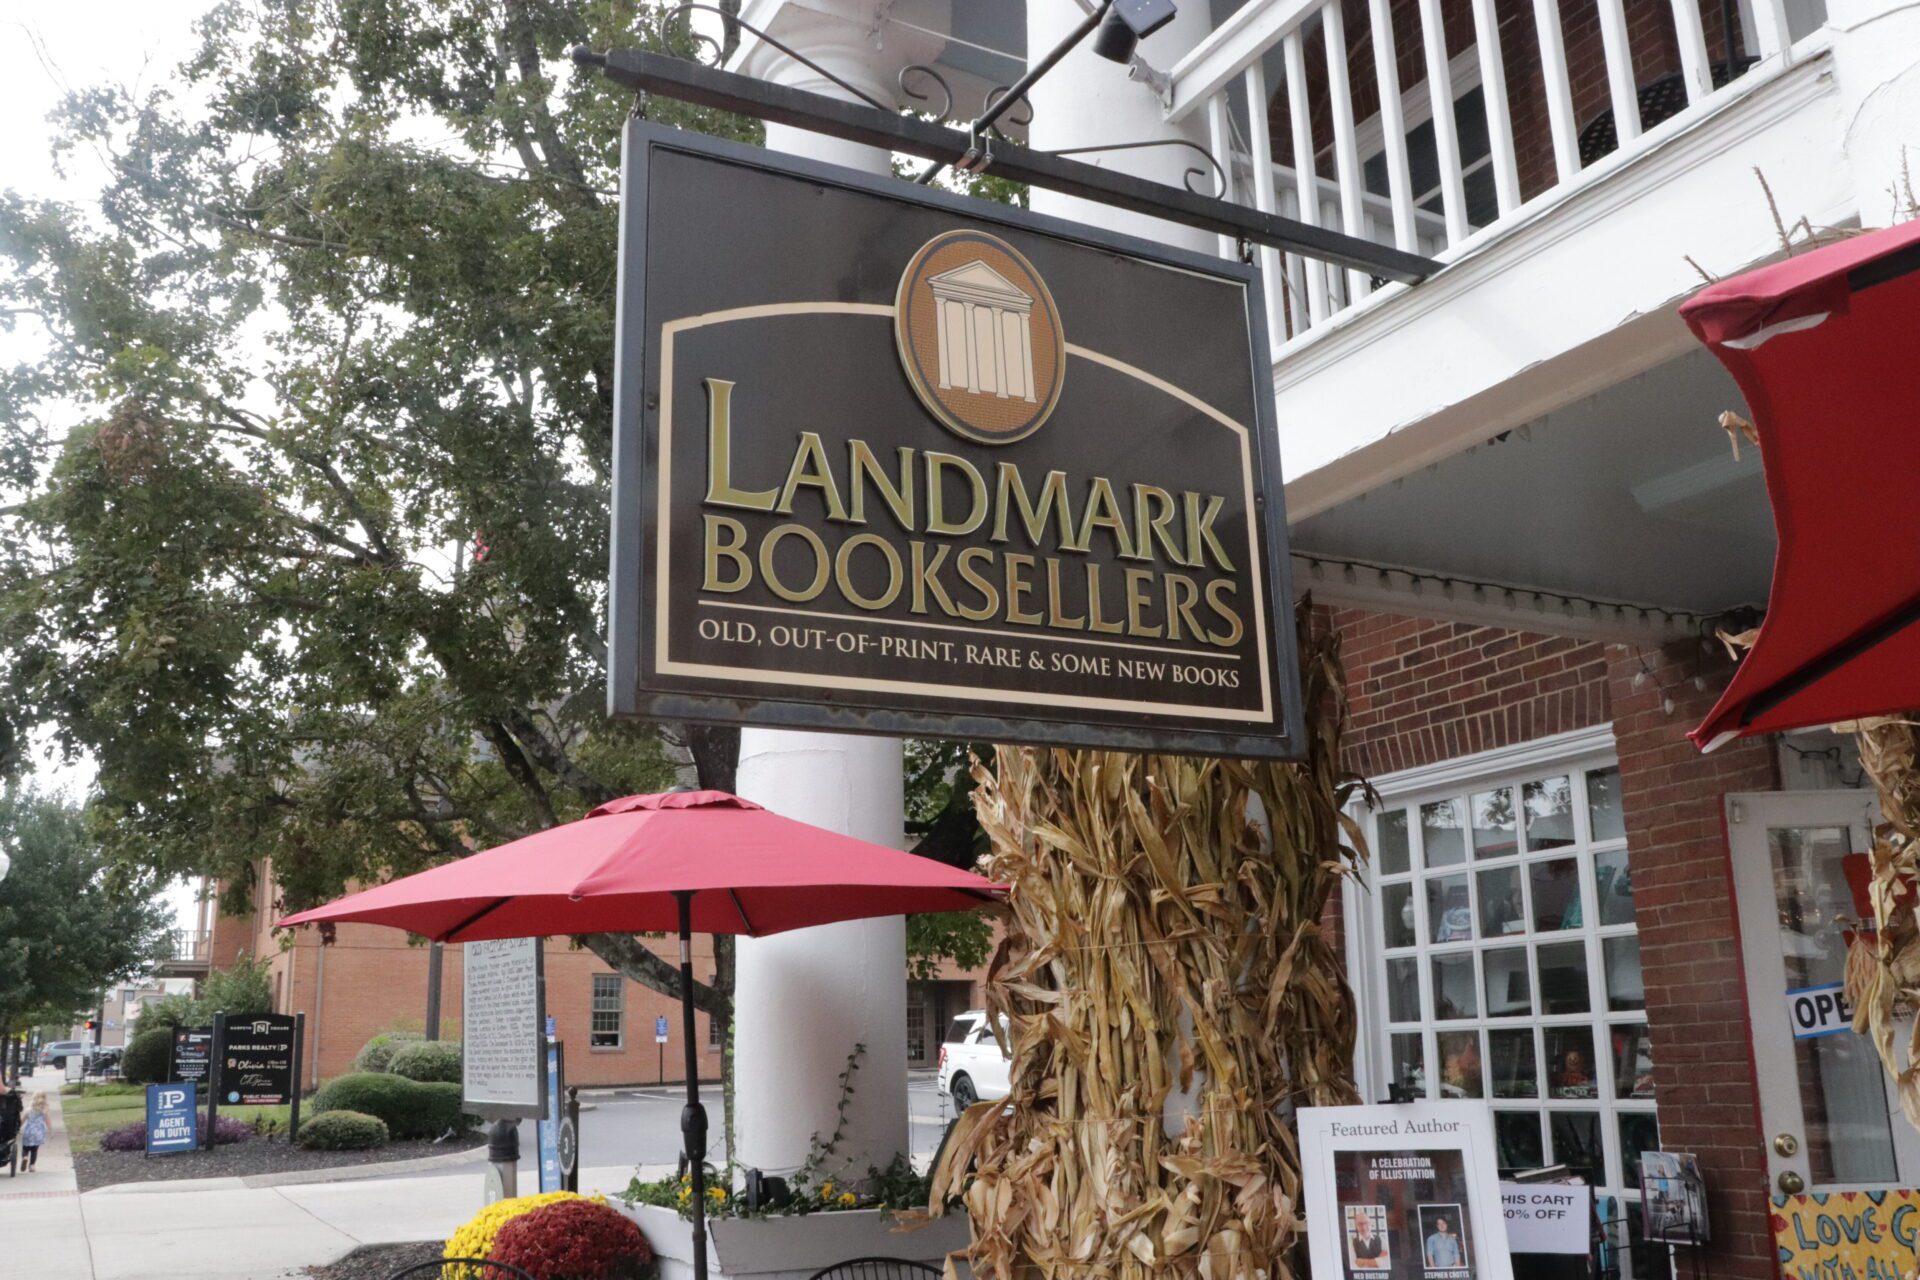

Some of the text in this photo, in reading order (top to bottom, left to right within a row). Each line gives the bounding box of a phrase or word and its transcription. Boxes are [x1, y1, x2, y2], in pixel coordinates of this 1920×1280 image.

[704, 377, 1237, 572] LANDMARK
[702, 514, 1244, 647] BOOKSELLERS
[698, 619, 1240, 688] OLD, OUT-OF-PRINT, RARE & SOME NEW BOOKS
[1794, 991, 1855, 1029] OPE
[237, 1060, 265, 1070] Olivia
[159, 1117, 186, 1129] AGENT
[1331, 1118, 1460, 1137] Featured Author
[153, 1126, 191, 1139] ON DUTY!
[1371, 1157, 1432, 1168] A CELEBRATION
[1368, 1169, 1436, 1180] OF ILLUSTRATION
[1501, 1194, 1575, 1206] HIS CART
[1535, 1209, 1566, 1220] OFF
[1791, 1205, 1882, 1250] LOVE
[1424, 1271, 1448, 1280] STEPHEN
